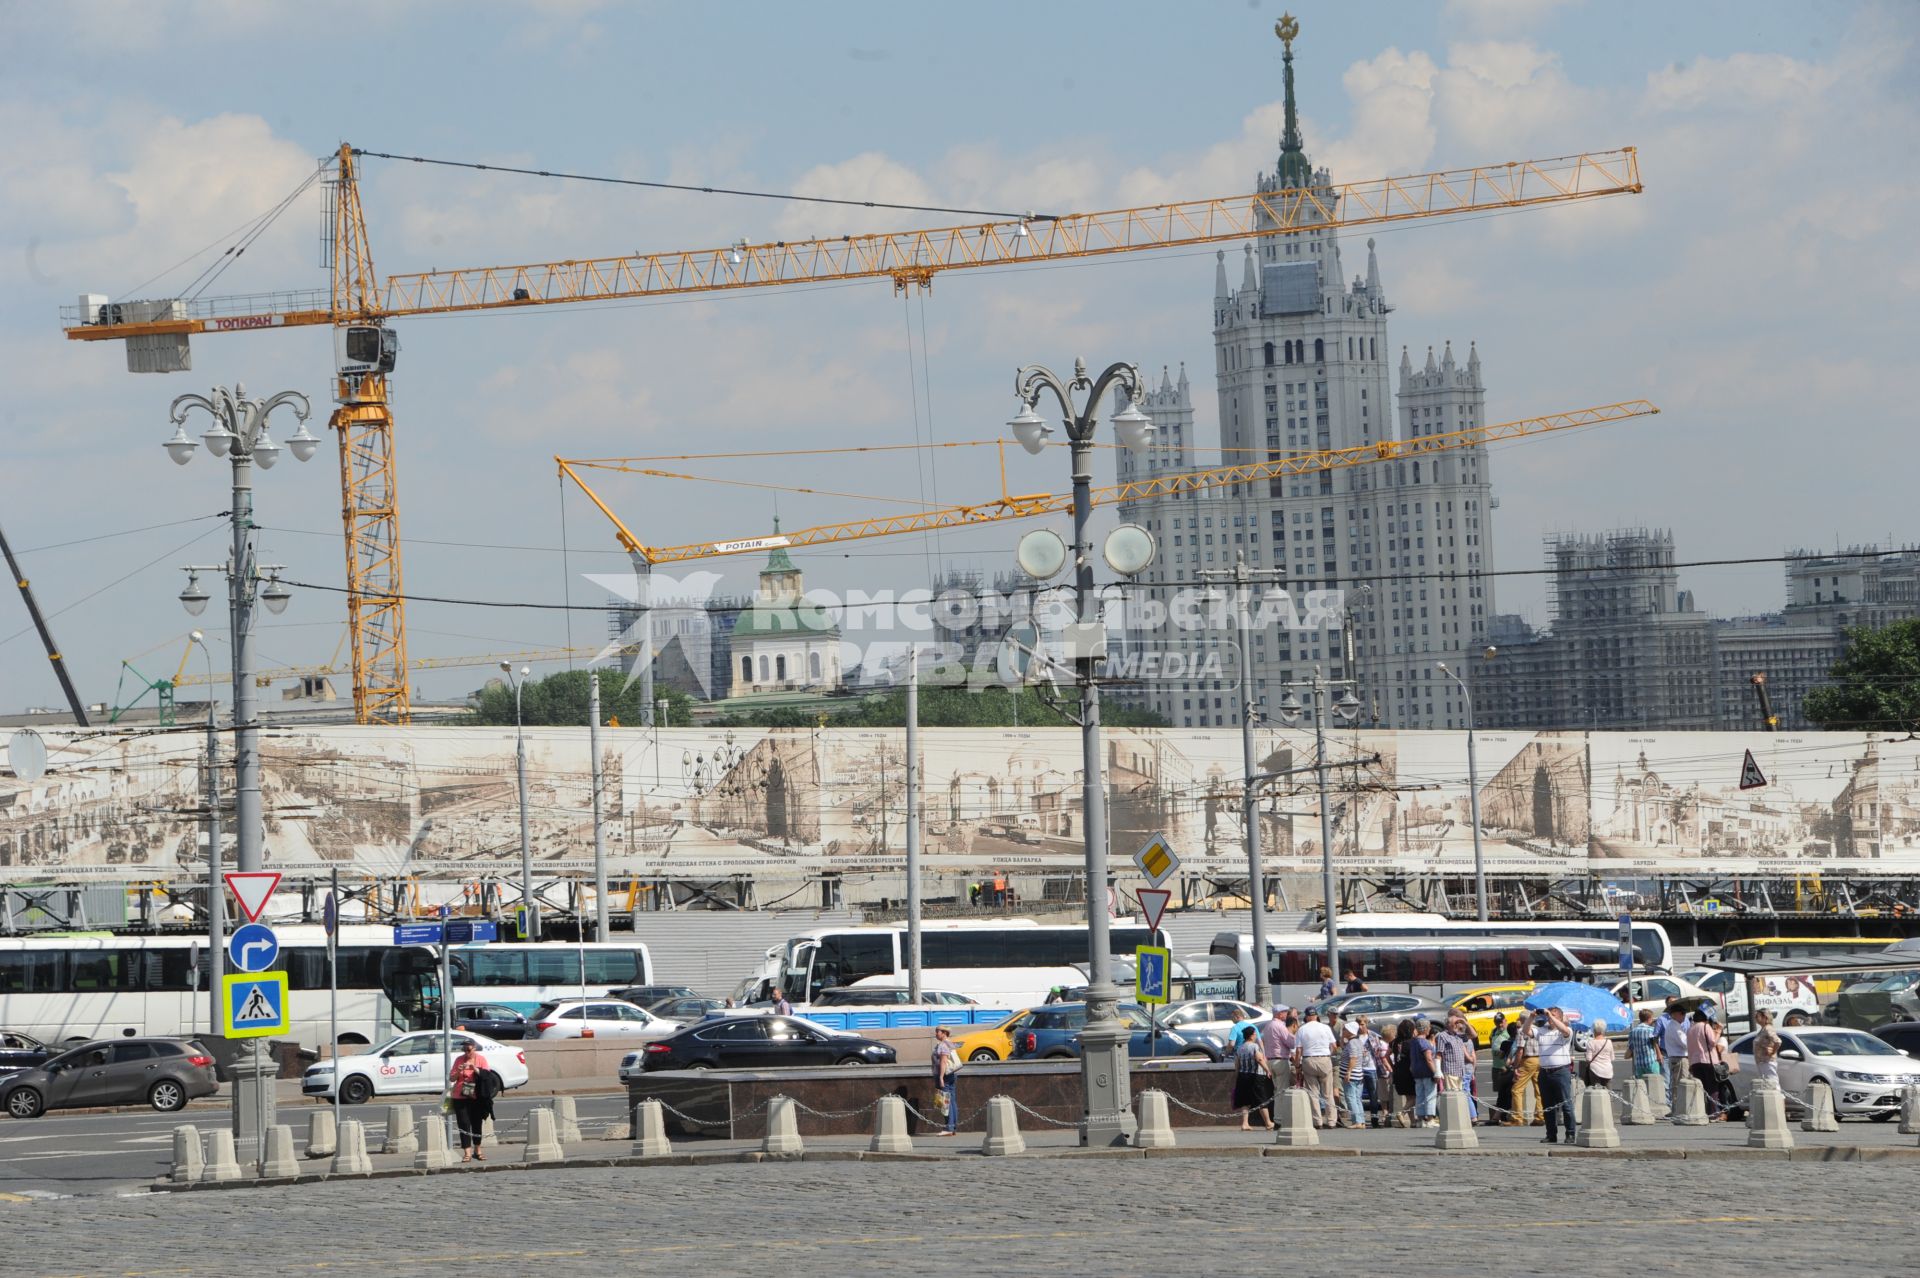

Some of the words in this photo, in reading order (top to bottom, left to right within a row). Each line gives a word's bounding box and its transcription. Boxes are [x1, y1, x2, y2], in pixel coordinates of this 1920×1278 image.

[725, 541, 763, 550] POTAIN
[645, 860, 697, 868] КИТАЙГОРОДСКАЯ
[1198, 985, 1236, 996] ЖЕЛАНИЙ
[380, 1065, 396, 1075] Go
[399, 1064, 423, 1074] TAXI
